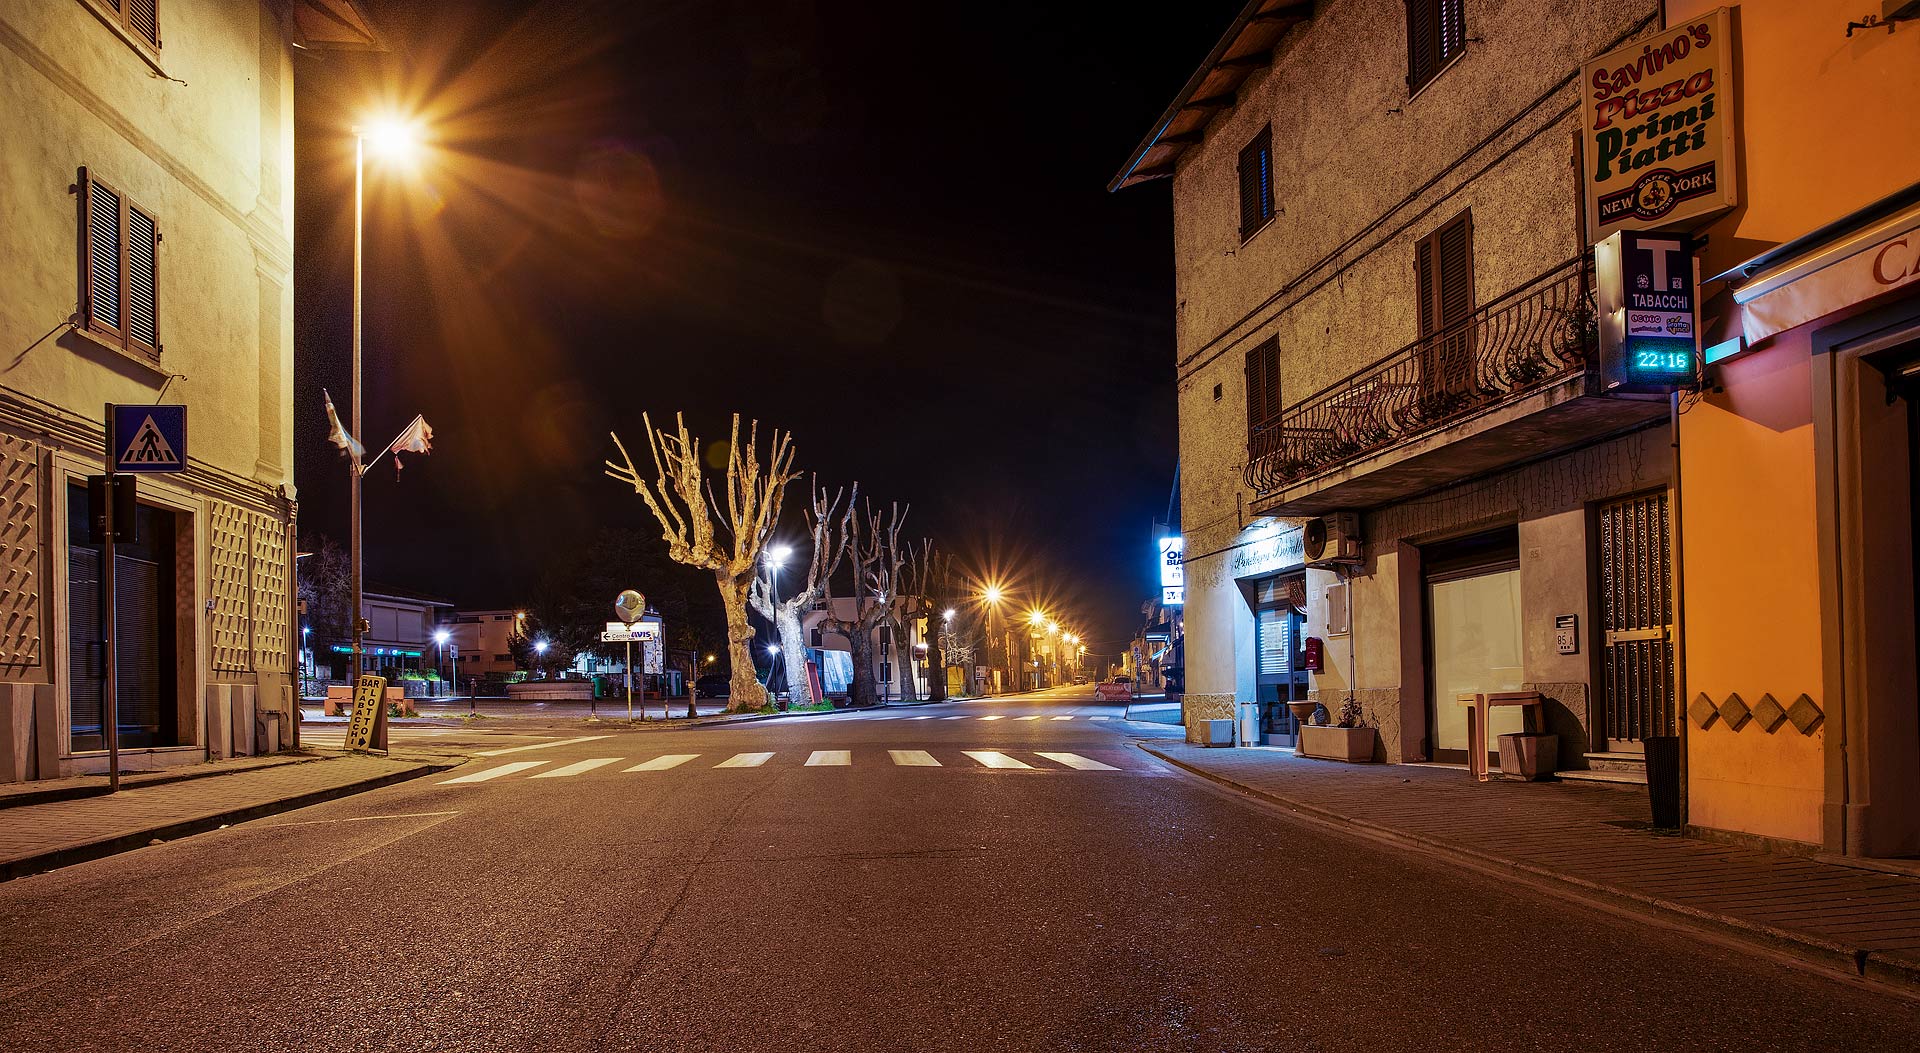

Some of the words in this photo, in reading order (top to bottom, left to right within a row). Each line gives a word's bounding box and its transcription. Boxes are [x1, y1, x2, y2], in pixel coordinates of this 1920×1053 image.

[1593, 23, 1711, 99] Savino's
[1593, 68, 1714, 130] Pizza
[1594, 93, 1715, 182] Primi
[1602, 194, 1635, 216] NEW
[1672, 172, 1713, 194] YORK
[1636, 207, 1652, 216] DAL
[1636, 239, 1681, 291] T
[1873, 238, 1920, 285] C
[1632, 294, 1688, 309] TABACCHI
[1638, 352, 1687, 368] 22:16
[1557, 635, 1567, 645] 85
[361, 679, 380, 688] BAR
[350, 688, 368, 745] TABACCHI
[360, 689, 376, 735] LOTTO
